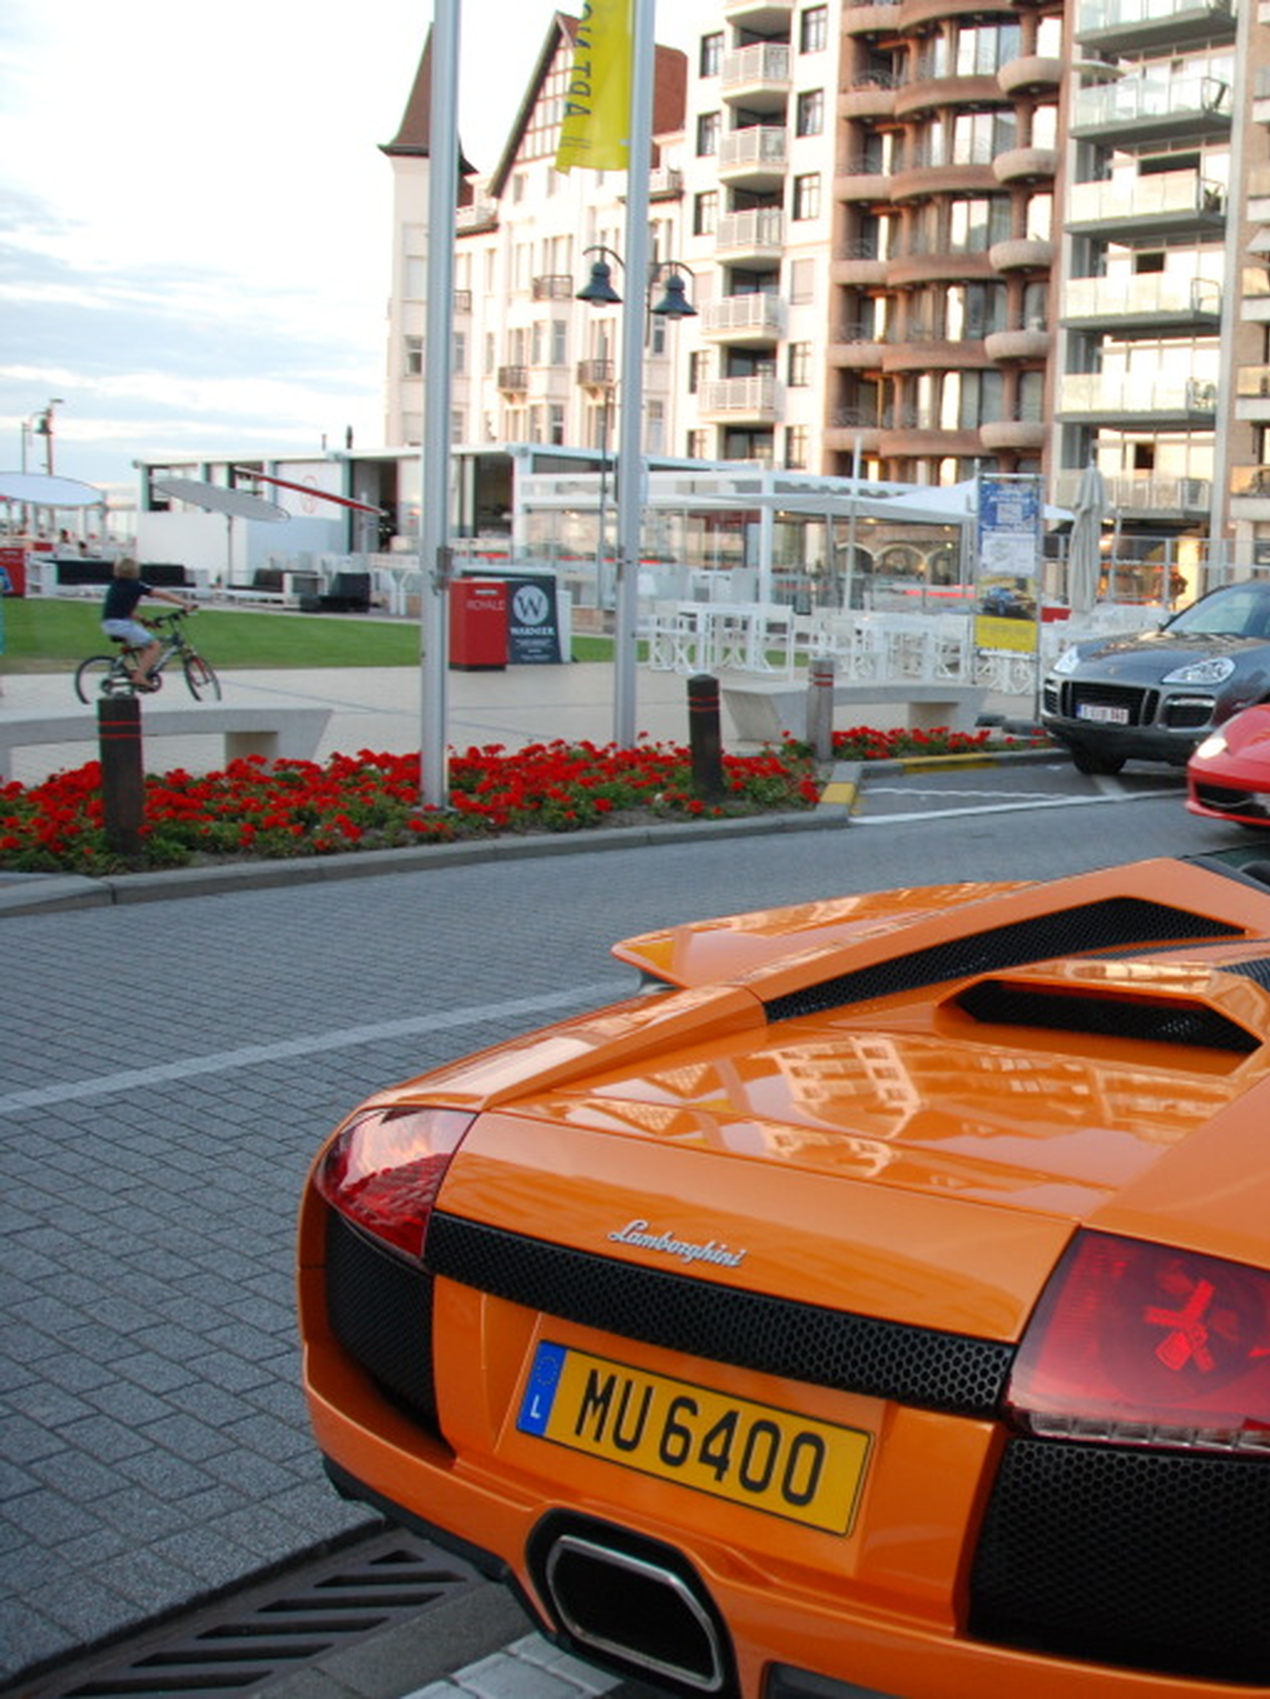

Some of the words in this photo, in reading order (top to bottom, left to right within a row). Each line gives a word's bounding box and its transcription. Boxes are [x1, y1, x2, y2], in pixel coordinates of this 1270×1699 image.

[607, 1219, 749, 1267] Lamborghini
[529, 1395, 541, 1419] L
[574, 1368, 653, 1452] MU
[659, 1396, 826, 1507] 6400
